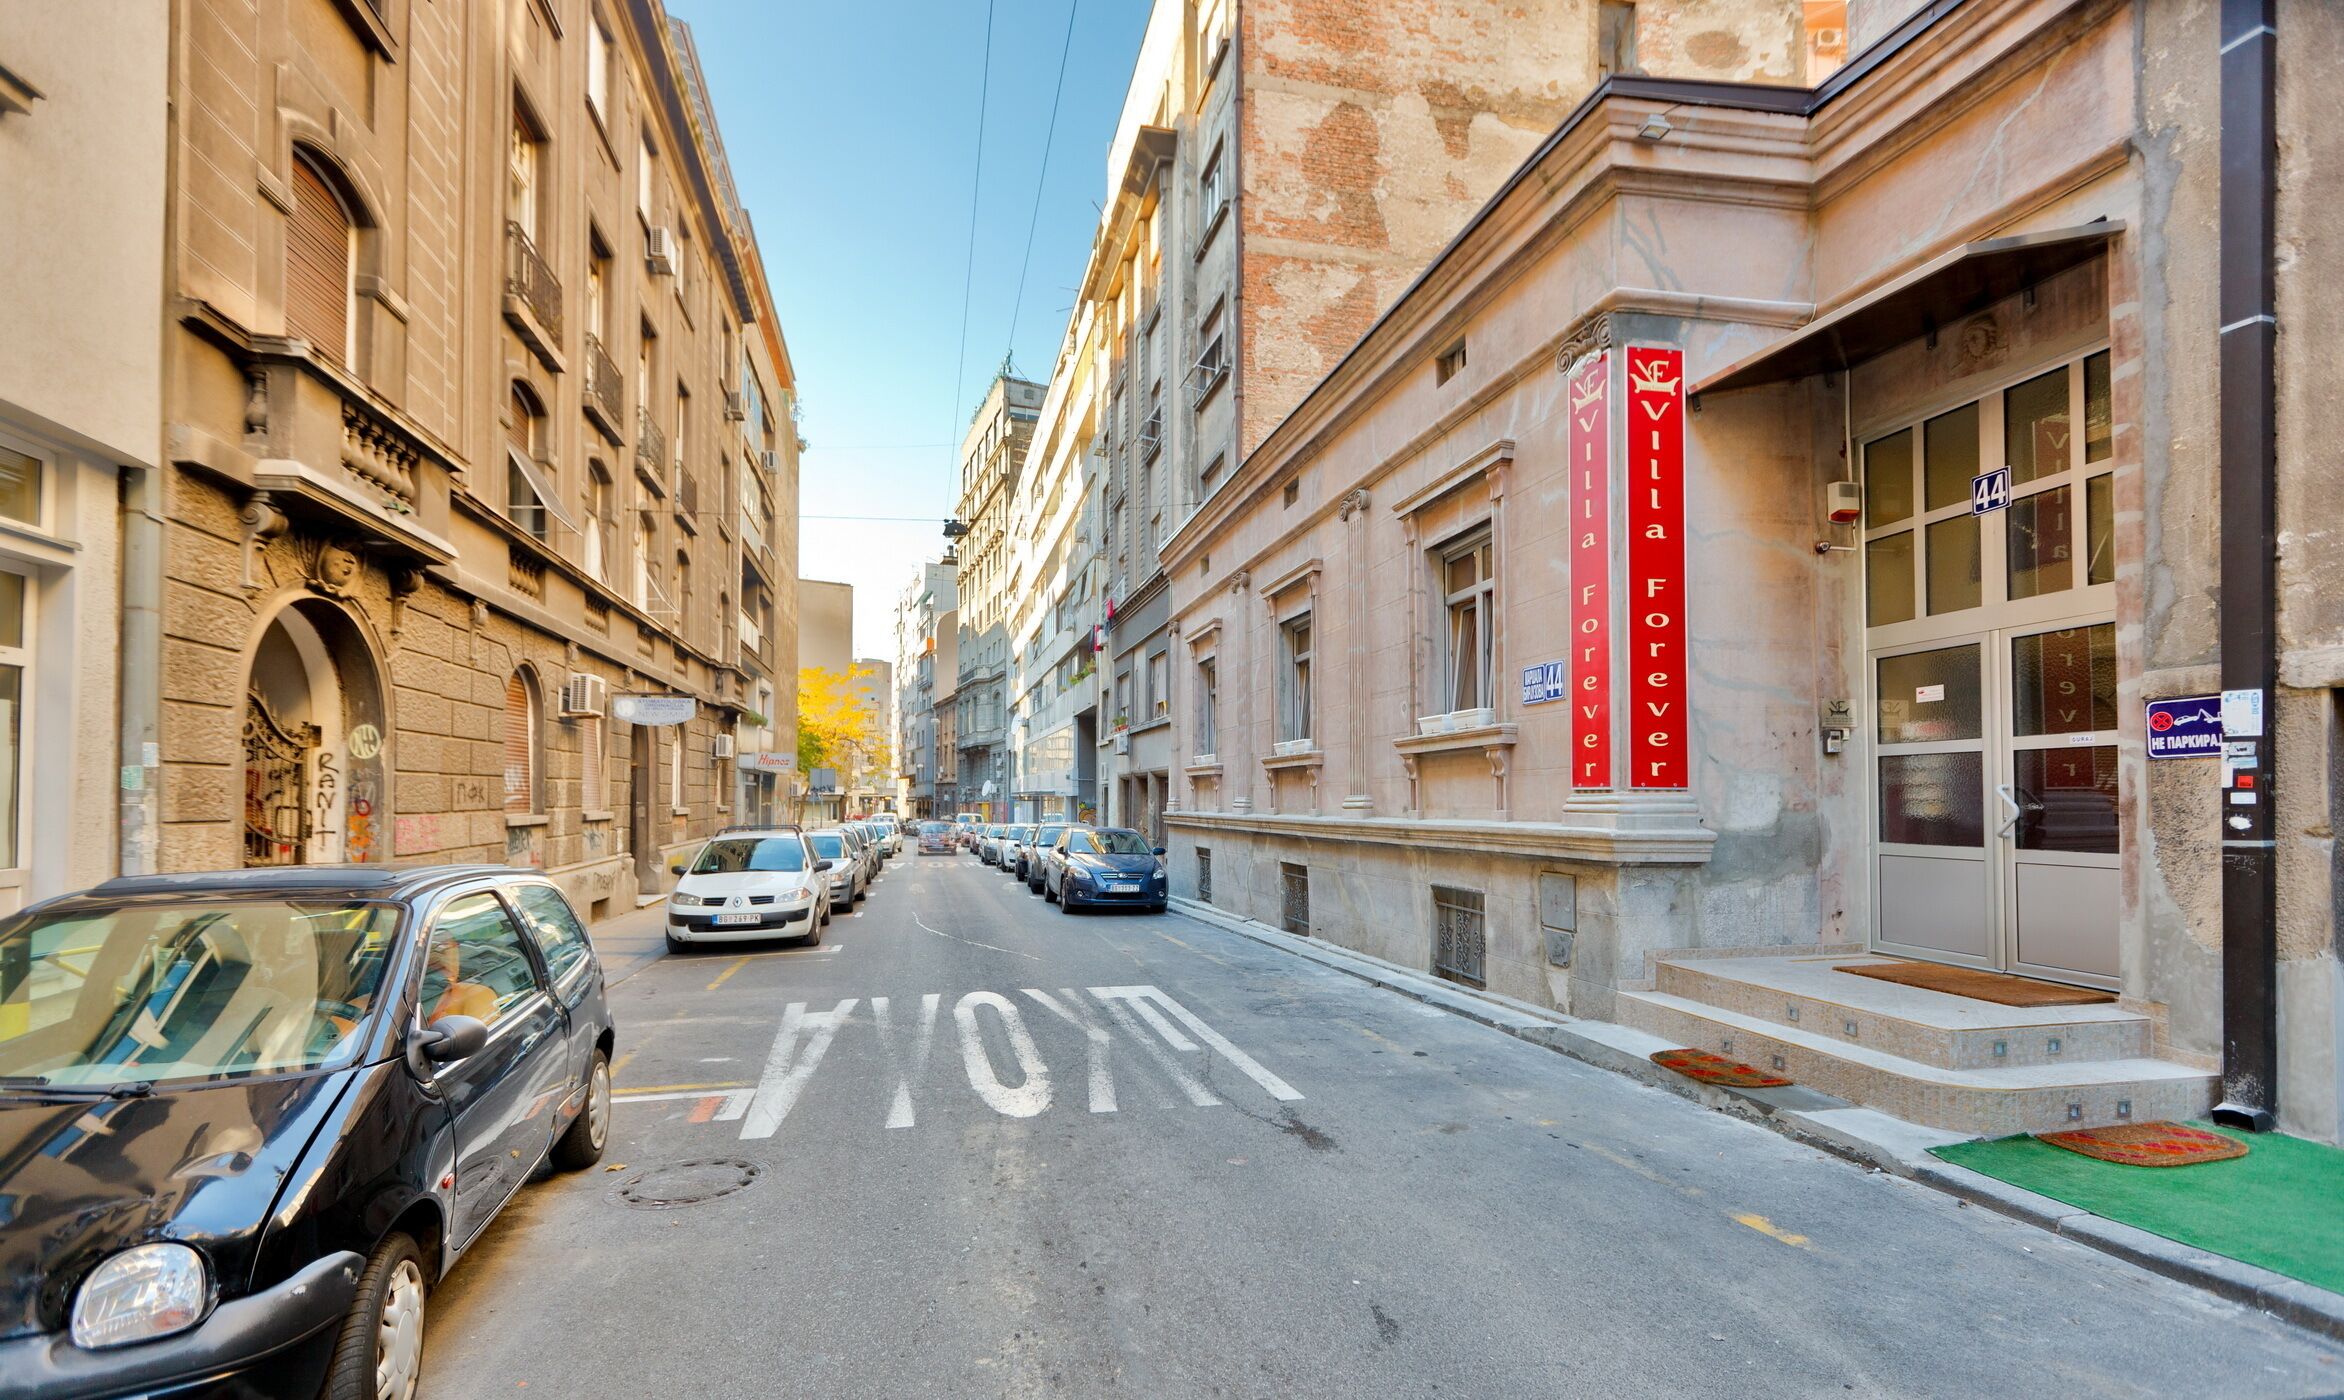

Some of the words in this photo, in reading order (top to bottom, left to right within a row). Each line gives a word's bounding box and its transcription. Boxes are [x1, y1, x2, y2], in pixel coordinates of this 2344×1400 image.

[1578, 409, 1599, 549] Villa
[1640, 400, 1671, 540] Villa
[1976, 473, 2006, 509] 44
[1547, 664, 1562, 697] 44
[1581, 584, 1599, 777] Forever
[1645, 578, 1670, 777] Forever
[2152, 737, 2165, 750] НЕ
[738, 985, 1306, 1140] ШКОЛА
